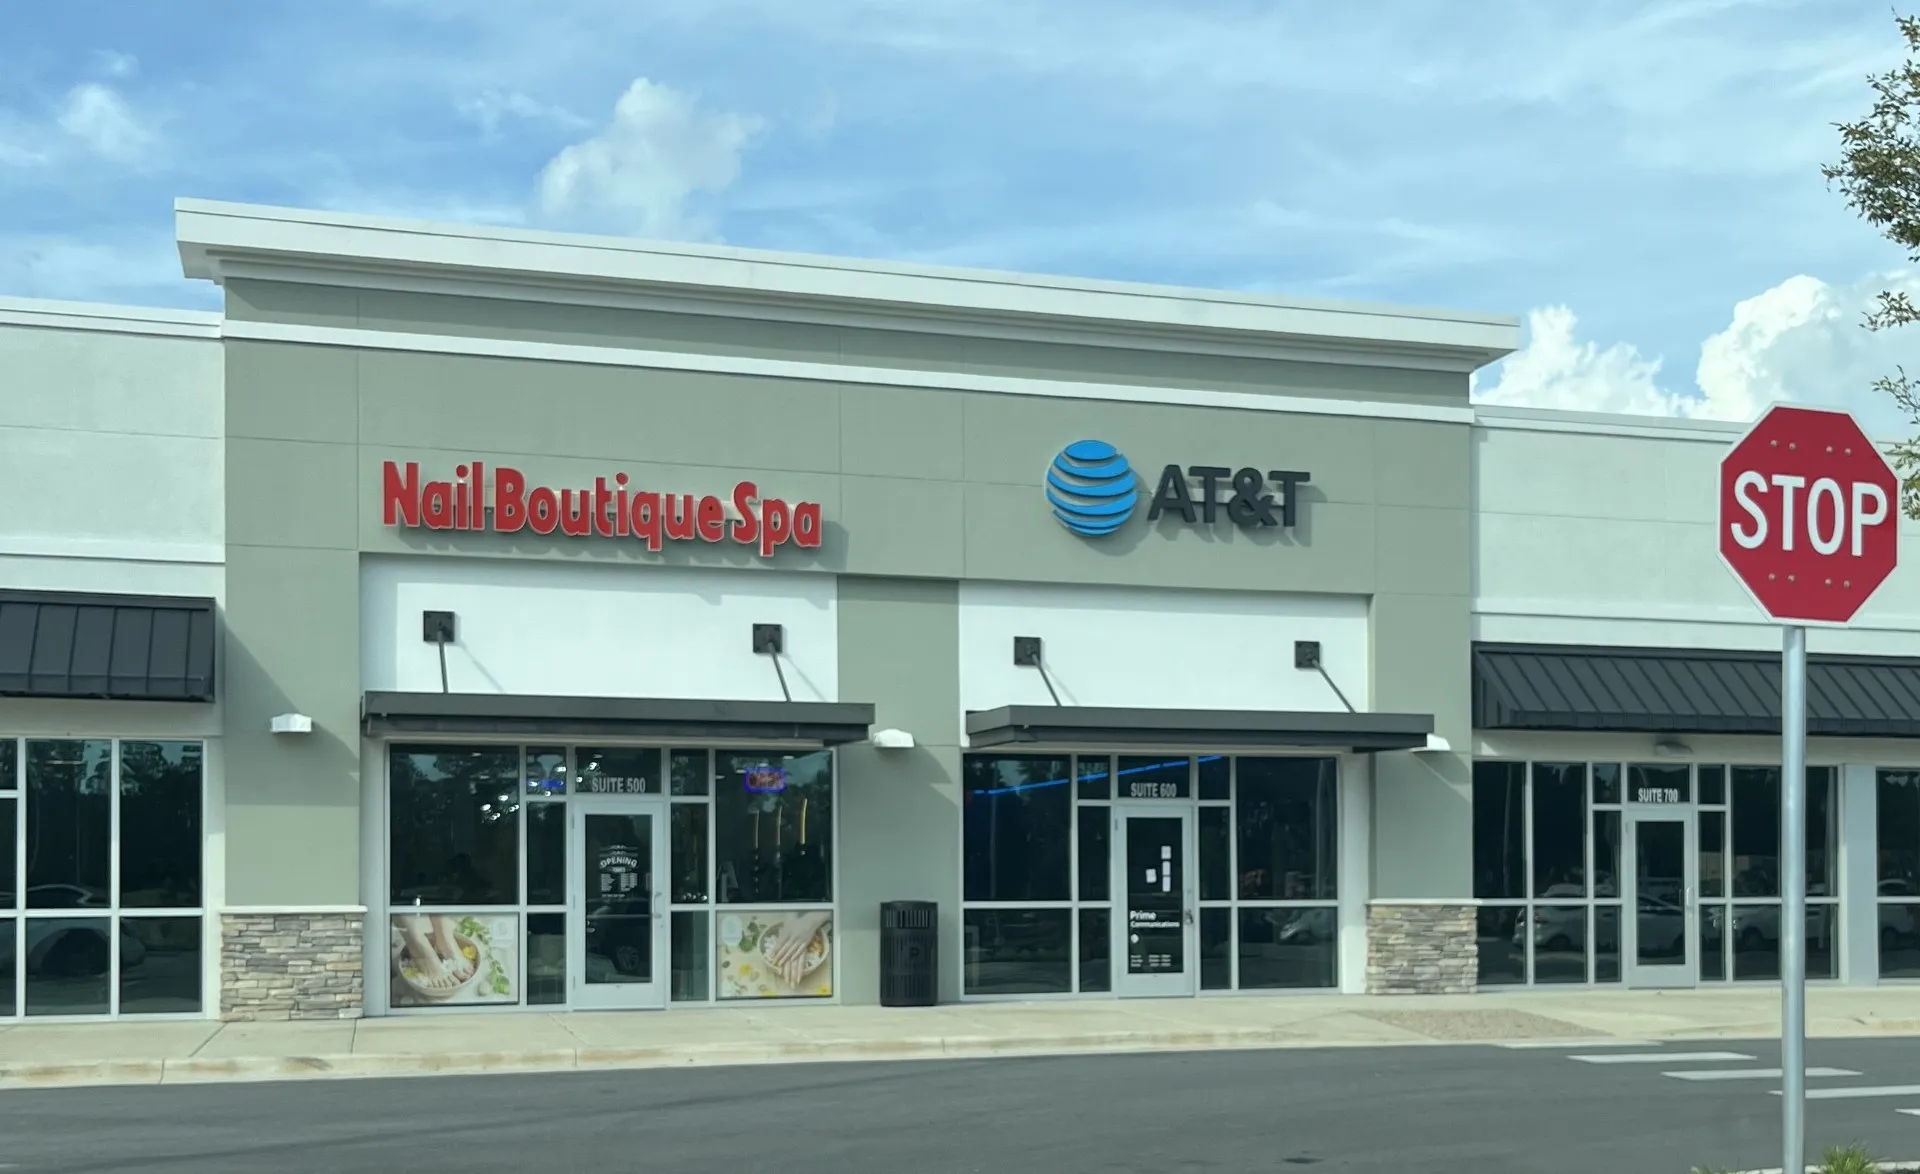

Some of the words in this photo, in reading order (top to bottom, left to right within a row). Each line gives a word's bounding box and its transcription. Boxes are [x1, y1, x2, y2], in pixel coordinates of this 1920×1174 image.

[1147, 464, 1311, 527] AT&T
[382, 460, 484, 530] Nail
[493, 467, 725, 551] Boutique
[731, 481, 822, 557] Spa
[1730, 470, 1888, 557] STOP
[592, 777, 624, 793] SUITE
[627, 777, 646, 793] 500
[1131, 782, 1158, 798] SUITE
[1160, 782, 1177, 798] 600
[1638, 788, 1662, 803] SUITE
[1664, 788, 1678, 803] 700
[600, 856, 638, 868] OPENING
[1130, 910, 1156, 920] Prime
